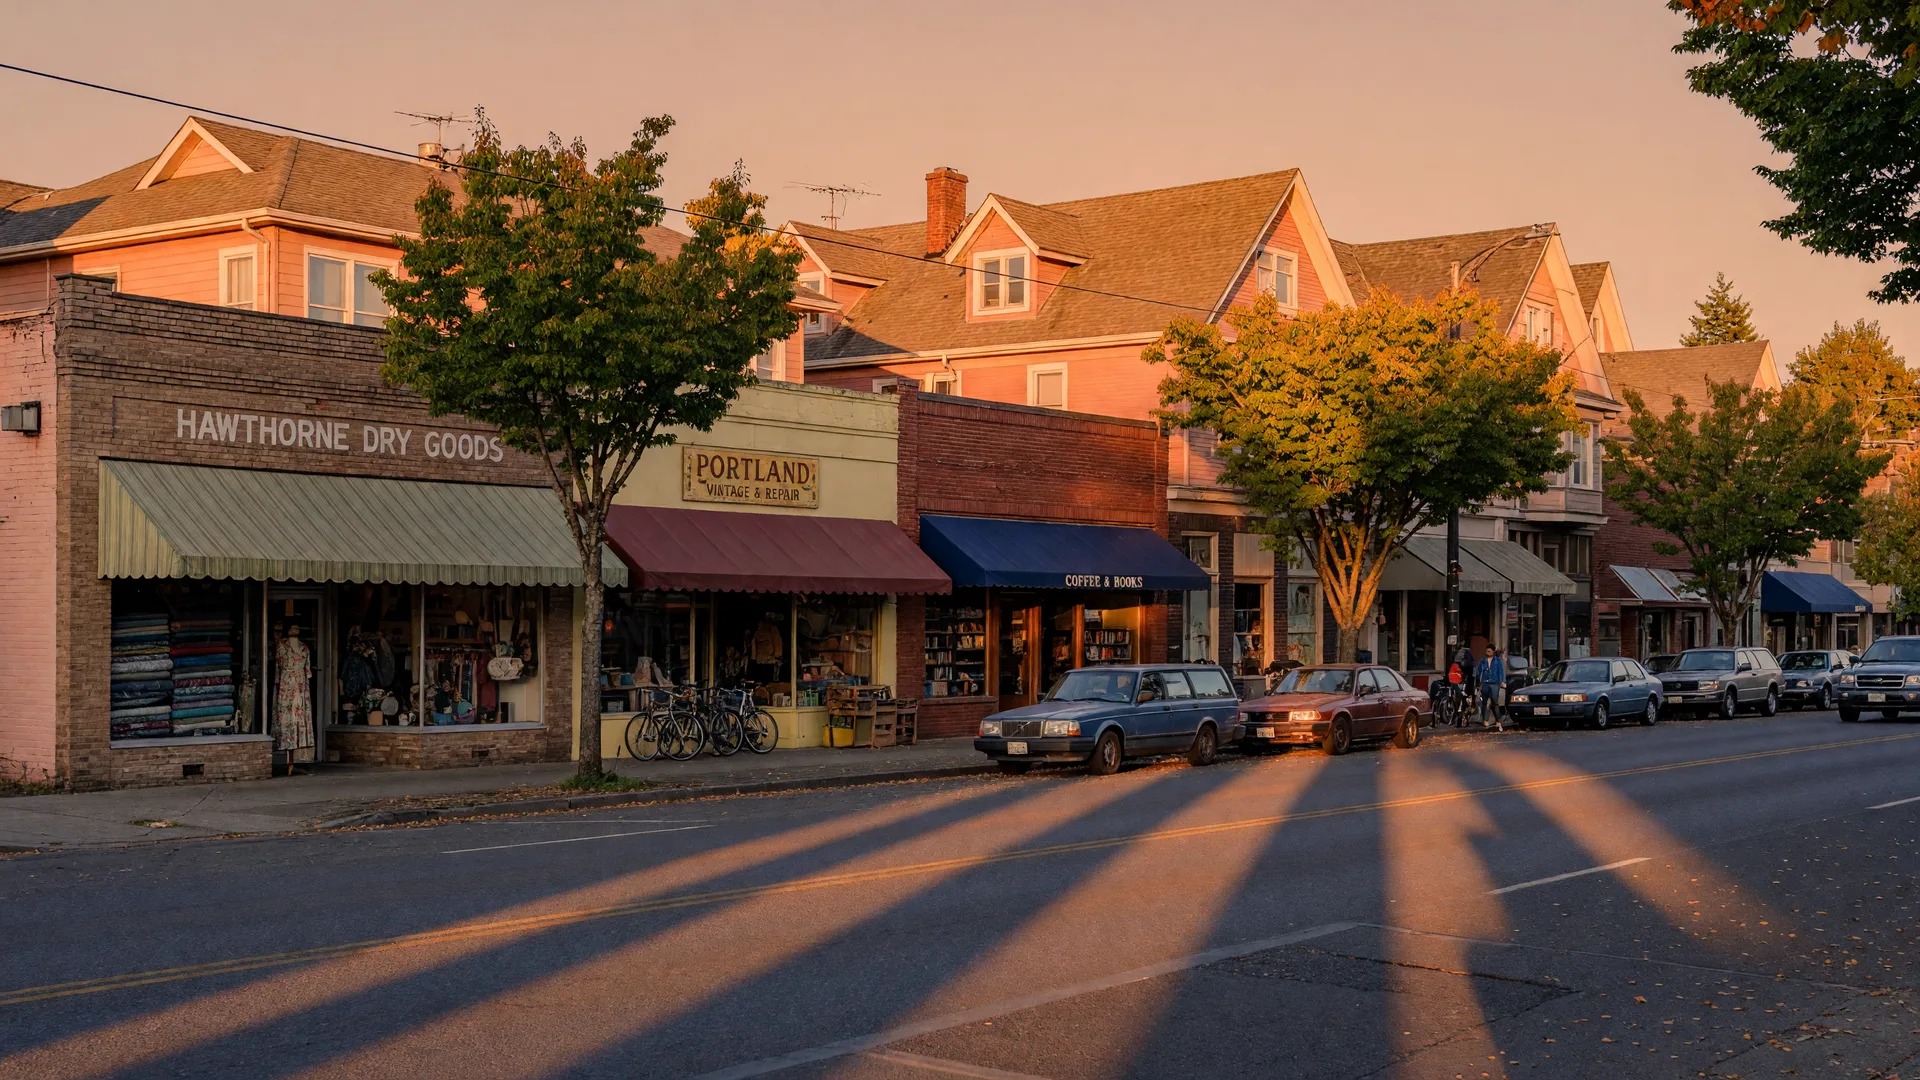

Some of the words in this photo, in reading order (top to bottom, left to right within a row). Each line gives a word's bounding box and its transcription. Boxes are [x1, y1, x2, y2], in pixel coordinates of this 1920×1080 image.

[176, 408, 350, 451] HAWTHORNE
[363, 425, 412, 455] DRY
[424, 431, 504, 463] GOODS
[696, 453, 810, 484] PORTLAND
[706, 483, 750, 498] VINTAGE
[754, 487, 760, 499] &
[765, 487, 800, 501] REPAIR
[1065, 574, 1101, 587] COFFEE
[1104, 576, 1110, 588] &
[1113, 576, 1143, 588] BOOKS
